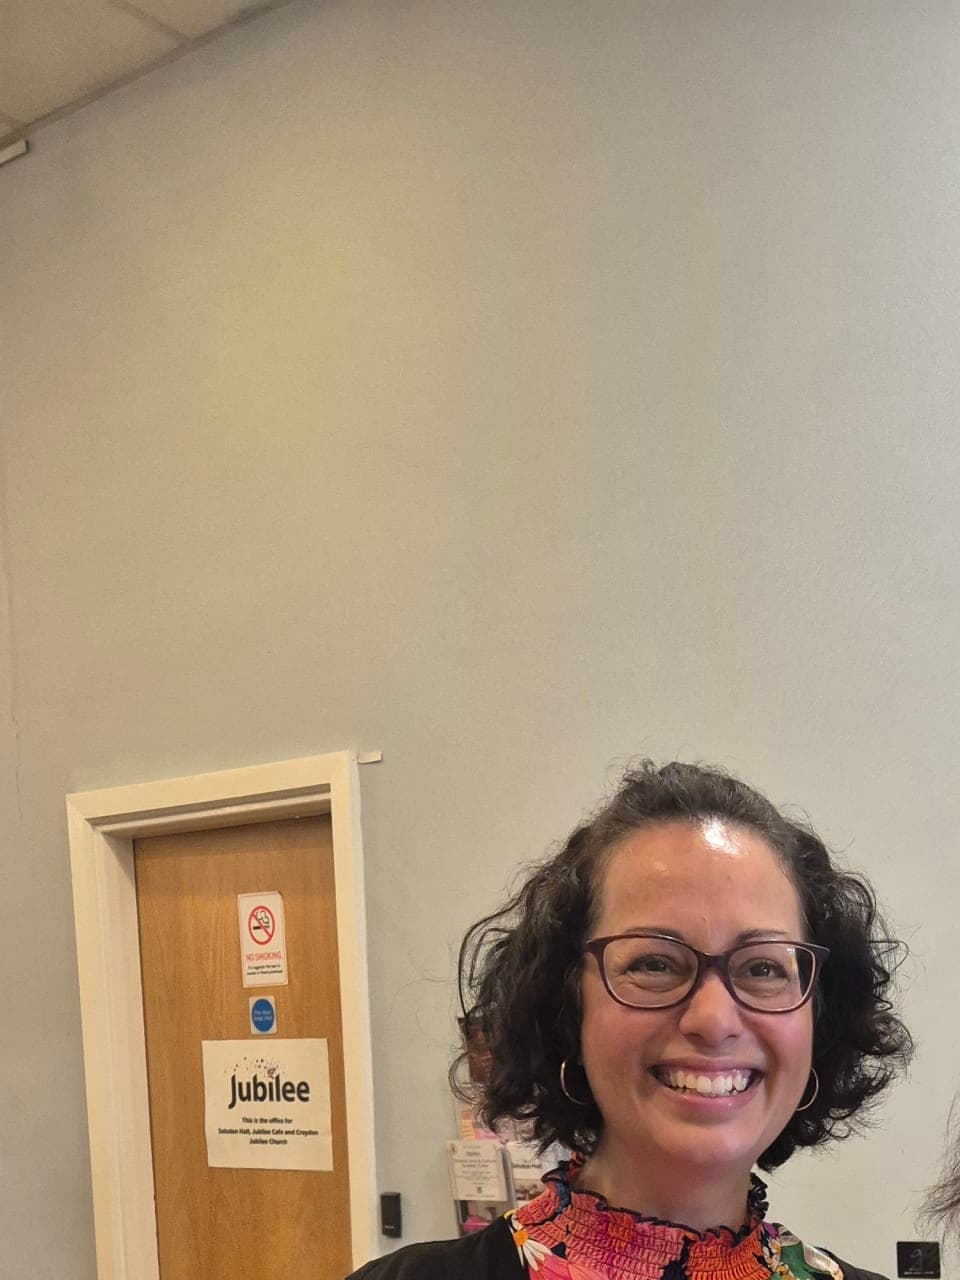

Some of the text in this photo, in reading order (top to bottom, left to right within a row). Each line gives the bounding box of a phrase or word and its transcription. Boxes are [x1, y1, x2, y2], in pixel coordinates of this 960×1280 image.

[245, 951, 282, 961] NO SMOKING
[228, 1074, 310, 1109] Jubilee
